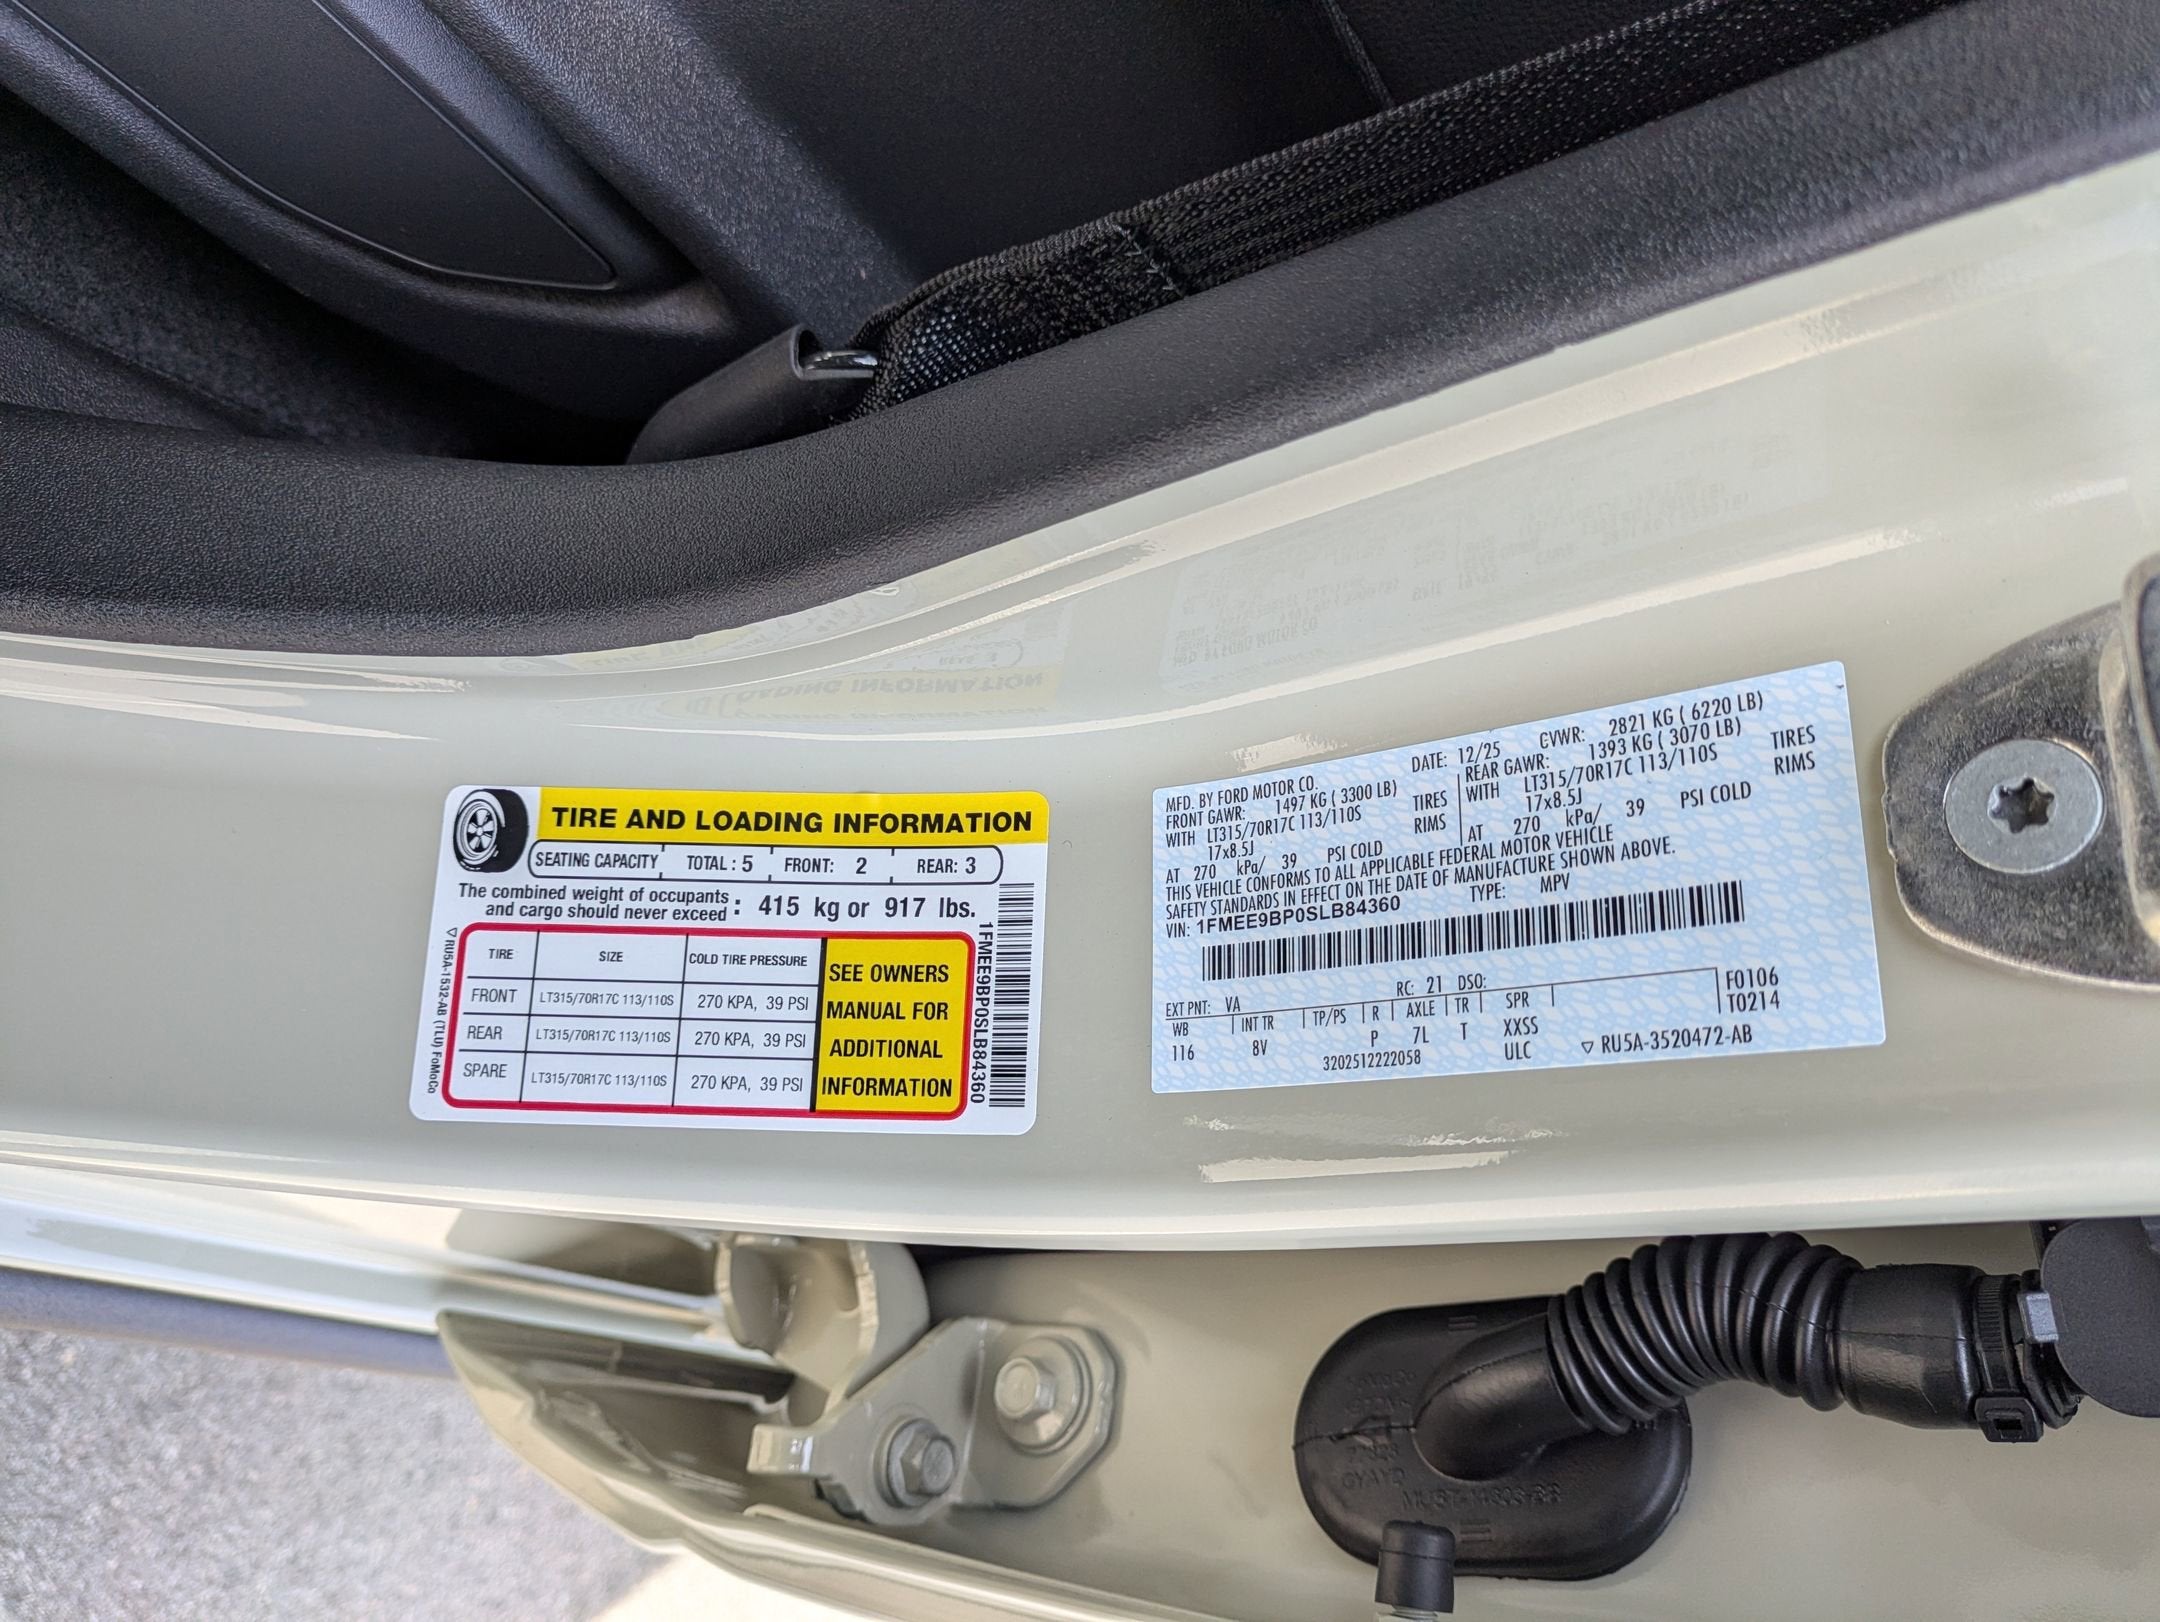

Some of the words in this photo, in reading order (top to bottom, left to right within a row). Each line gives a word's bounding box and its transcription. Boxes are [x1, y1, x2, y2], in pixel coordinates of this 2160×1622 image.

[1609, 713, 1645, 736] 2821
[1653, 708, 1673, 728] KG
[1692, 697, 1731, 721] 6220
[1771, 725, 1815, 750] TIRES
[1412, 753, 1447, 773] DATE:
[1458, 741, 1500, 764] 12/25
[1465, 761, 1499, 783] REAR
[1504, 753, 1549, 775] GAWR:
[1589, 738, 1626, 760] 1393
[1632, 733, 1652, 753] KG
[1670, 722, 1710, 746] 3070
[1774, 751, 1815, 775] RIMS
[1466, 781, 1499, 802] WITH
[1524, 757, 1632, 793] LT315/70R17C
[1639, 742, 1717, 773] 113/110S
[1166, 795, 1194, 812] MFD.
[1199, 792, 1213, 808] BY
[1218, 787, 1248, 806] FORD
[1253, 779, 1295, 800] MOTOR
[1299, 775, 1318, 792] CO.
[1413, 790, 1447, 811] TIRES
[1526, 787, 1582, 812] 17x8.5J
[1166, 811, 1203, 830] FRONT
[1208, 806, 1245, 824] GAWR:
[1276, 795, 1305, 814] 1497
[1311, 792, 1327, 809] KG
[1341, 784, 1372, 804] 3300
[1468, 824, 1483, 842] AT
[1514, 815, 1540, 835] 270
[1563, 803, 1602, 827] kPa/
[1626, 798, 1645, 817] 39
[1681, 788, 1703, 809] PSI
[1710, 781, 1751, 803] COLD
[552, 807, 617, 828] TIRE
[626, 809, 685, 829] AND
[696, 810, 822, 833] LOADING
[834, 811, 1031, 834] INFORMATION
[1166, 830, 1195, 848] WITH
[1208, 815, 1295, 843] LT315/70R17C
[1300, 804, 1361, 830] 113/110S
[1414, 813, 1446, 834] RIMS
[1208, 840, 1254, 861] 17x8.5J
[535, 852, 590, 867] SEATING
[595, 853, 659, 869] CAPACITY
[742, 855, 753, 872] 5
[784, 857, 834, 873] FRONT:
[856, 857, 867, 874] 2
[917, 858, 957, 873] REAR:
[965, 857, 976, 874] 3
[1166, 868, 1180, 884] AT
[1194, 864, 1216, 881] 270
[1237, 855, 1266, 876] kPa/
[1282, 853, 1297, 869] 39
[1328, 846, 1345, 863] PSI
[1351, 840, 1383, 859] COLD
[1166, 884, 1191, 902] THIS
[1195, 879, 1241, 898] VEHICLE
[1246, 869, 1311, 893] CONFORMS
[1315, 866, 1330, 884] TO
[1335, 863, 1356, 881] ALL
[1360, 851, 1434, 877] APPLICABLE
[1440, 842, 1496, 866] FEDERAL
[1501, 834, 1551, 857] MOTOR
[1555, 824, 1613, 849] VEHICLE
[1166, 901, 1207, 920] SAFETY
[1211, 892, 1279, 916] STANDARDS
[1284, 890, 1295, 907] IN
[1301, 884, 1341, 904] EFFECT
[1346, 881, 1363, 898] ON
[1368, 877, 1391, 896] THE
[1396, 872, 1427, 892] DATE
[1432, 869, 1448, 887] OF
[1454, 853, 1555, 884] MANUFACTURE
[1560, 845, 1615, 869] SHOWN
[1621, 836, 1675, 861] ABOVE.
[1470, 882, 1505, 902] TYPE:
[1540, 872, 1570, 893] MPV
[459, 883, 487, 898] The
[492, 884, 566, 900] combined
[572, 886, 624, 904] weight
[629, 887, 644, 902] of
[649, 889, 729, 906] occupants
[486, 902, 514, 916] and
[519, 905, 563, 920] cargo
[567, 903, 619, 919] should
[624, 908, 668, 920] never
[672, 907, 727, 921] exceed
[759, 895, 799, 916] 415
[814, 897, 839, 922] kg
[848, 902, 870, 918] or
[885, 897, 926, 918] 917
[939, 897, 975, 918] lbs.
[1166, 922, 1190, 938] VIN:
[1194, 893, 1400, 934] 1FMEE9BP0SLB84360
[489, 949, 513, 959] TIRE
[599, 951, 623, 962] SIZE
[689, 953, 718, 964] COLD
[722, 954, 746, 965] TIRE
[750, 955, 807, 966] PRESSURE
[829, 963, 863, 982] SEE
[871, 964, 949, 983] OWNERS
[1726, 967, 1779, 990] F0106
[1397, 980, 1414, 997] RC:
[1427, 976, 1441, 994] 21
[1458, 973, 1486, 991] DSO:
[472, 988, 517, 1002] FRONT
[540, 992, 619, 1006] LT315/70R17C
[623, 994, 674, 1007] 113/110S
[698, 994, 723, 1008] 270
[727, 995, 757, 1011] KPA,
[766, 996, 783, 1010] 39
[788, 996, 808, 1011] PSI
[1166, 1002, 1184, 1017] EXT
[1188, 1000, 1210, 1015] PNT:
[1225, 996, 1240, 1012] VA
[1455, 997, 1469, 1013] TR
[1506, 991, 1529, 1009] SPR
[1727, 990, 1779, 1013] T0214
[827, 1001, 906, 1020] MANUAL
[913, 1002, 948, 1020] FOR
[970, 922, 993, 1103] 1FMEE9BP0SLB84360
[1313, 1008, 1346, 1027] TP/PS
[1406, 1000, 1435, 1018] AXLE
[431, 1020, 445, 1048] (TLU)
[467, 1025, 502, 1040] REAR
[536, 1029, 616, 1042] LT315/70R17C
[620, 1031, 671, 1044] 113/110S
[1172, 1022, 1188, 1037] WB
[1413, 1026, 1429, 1044] 7L
[1504, 1016, 1538, 1037] XXSS
[695, 1031, 720, 1045] 270
[724, 1032, 754, 1048] KPA,
[763, 1033, 781, 1047] 39
[785, 1033, 806, 1048] PSI
[829, 1039, 943, 1058] ADDITIONAL
[1253, 1039, 1267, 1056] 8V
[1602, 1024, 1752, 1053] RU5A-3520472-AB
[1173, 1044, 1194, 1061] 116
[1323, 1049, 1421, 1071] 3202512222058
[1505, 1041, 1531, 1060] ULC
[463, 1063, 507, 1078] SPARE
[531, 1072, 612, 1086] LT315/70R17C
[616, 1075, 667, 1088] 113/110S
[691, 1075, 717, 1089] 270
[721, 1076, 751, 1092] KPA,
[760, 1076, 777, 1091] 39
[782, 1077, 803, 1092] PSI
[822, 1077, 952, 1097] INFORMATION
